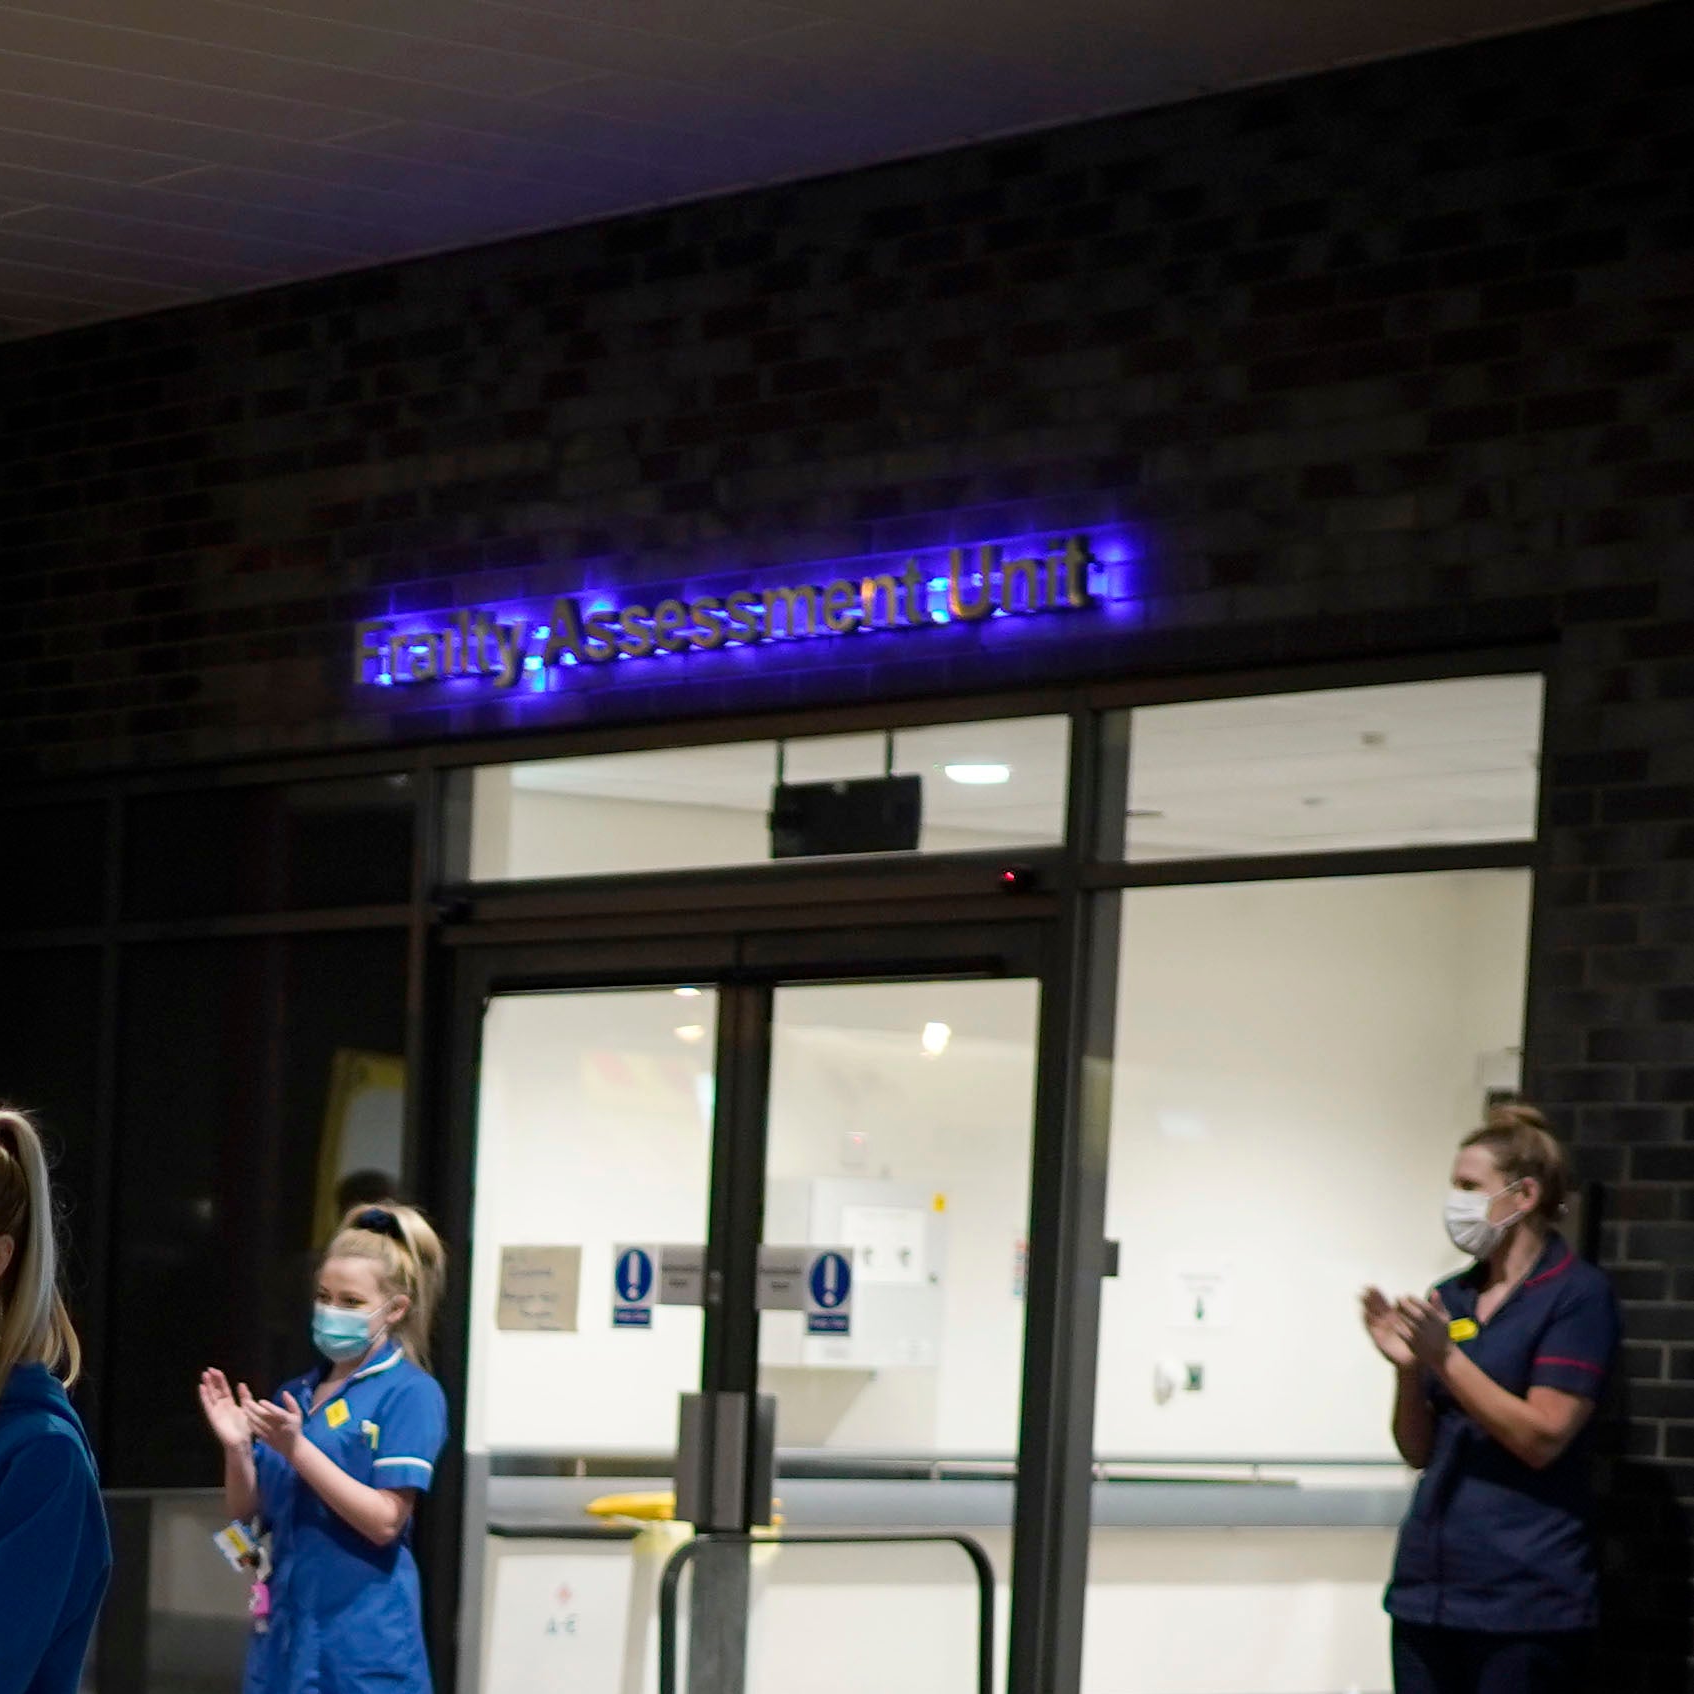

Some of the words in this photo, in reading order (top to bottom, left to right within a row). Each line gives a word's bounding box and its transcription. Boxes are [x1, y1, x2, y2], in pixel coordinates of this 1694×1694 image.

[353, 606, 524, 689] Frailty
[544, 557, 924, 666] Assessment
[948, 535, 1094, 621] Unit
